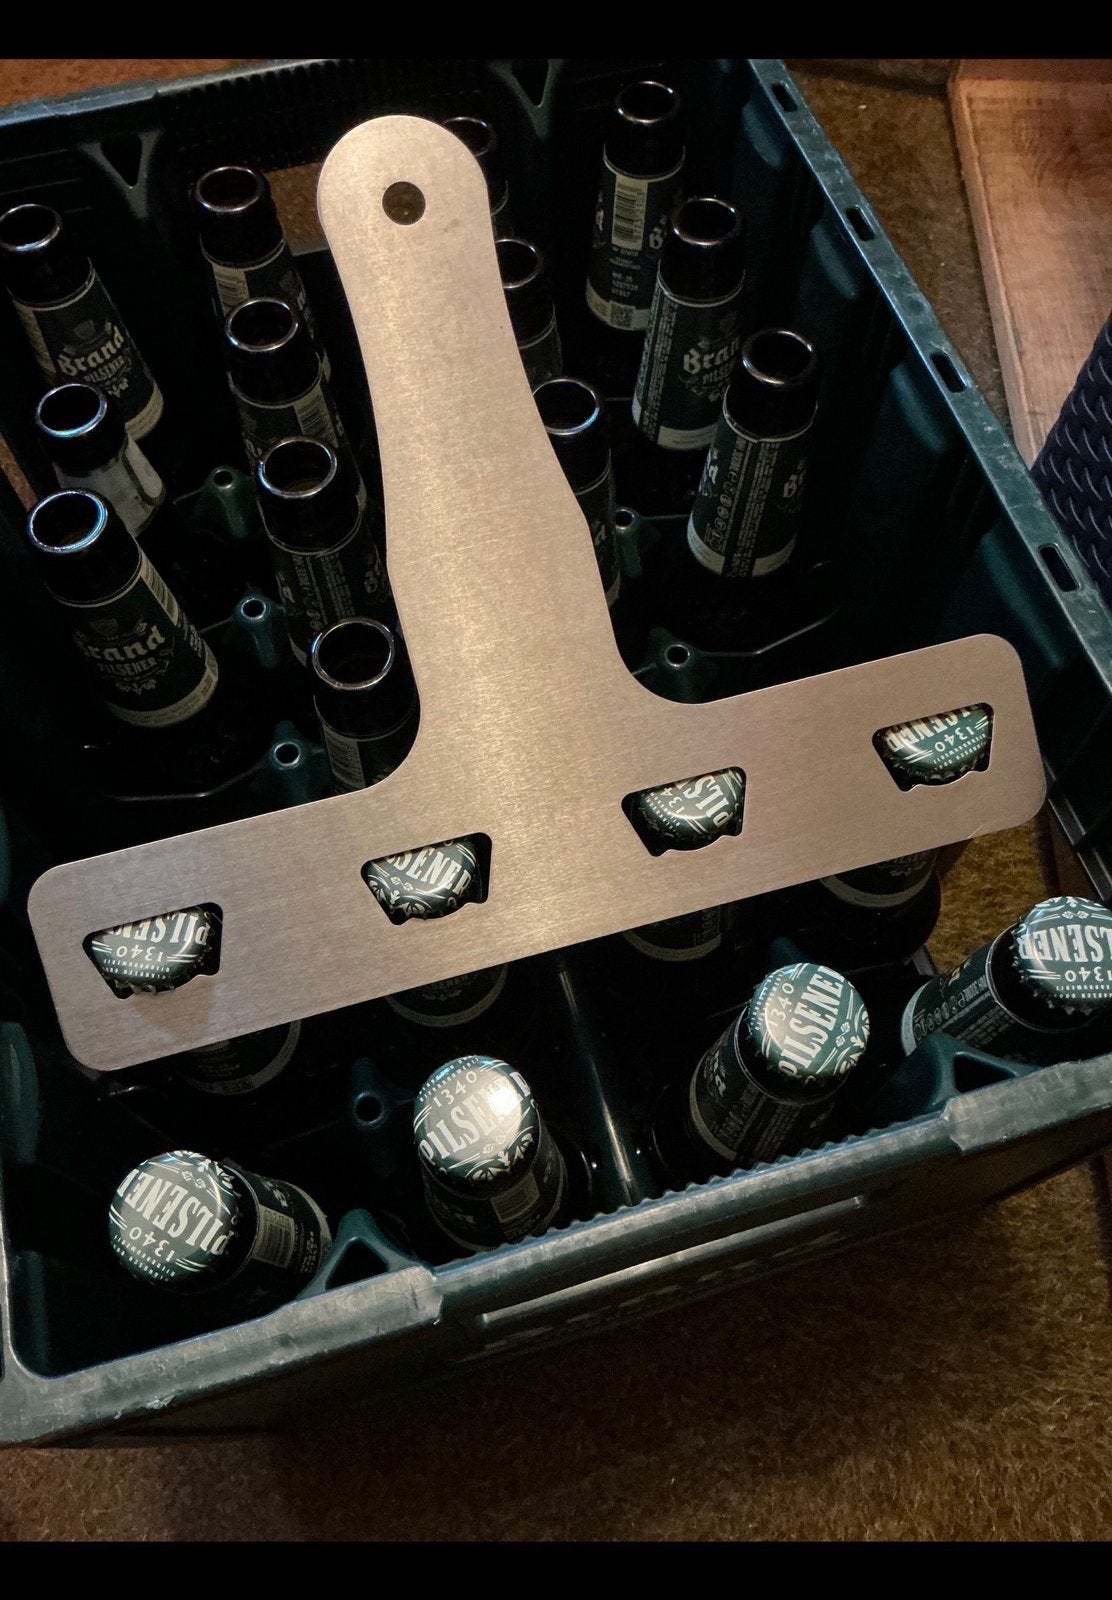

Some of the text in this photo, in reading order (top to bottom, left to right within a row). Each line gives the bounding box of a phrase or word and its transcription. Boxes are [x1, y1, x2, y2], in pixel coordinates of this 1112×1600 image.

[57, 325, 124, 376] Brand
[683, 336, 741, 374] Bran
[934, 727, 975, 752] 1340
[660, 787, 685, 814] 134
[116, 944, 164, 962] 1340
[769, 983, 795, 1027] 1340
[433, 1071, 478, 1108] 1340
[129, 1226, 176, 1262] 1340
